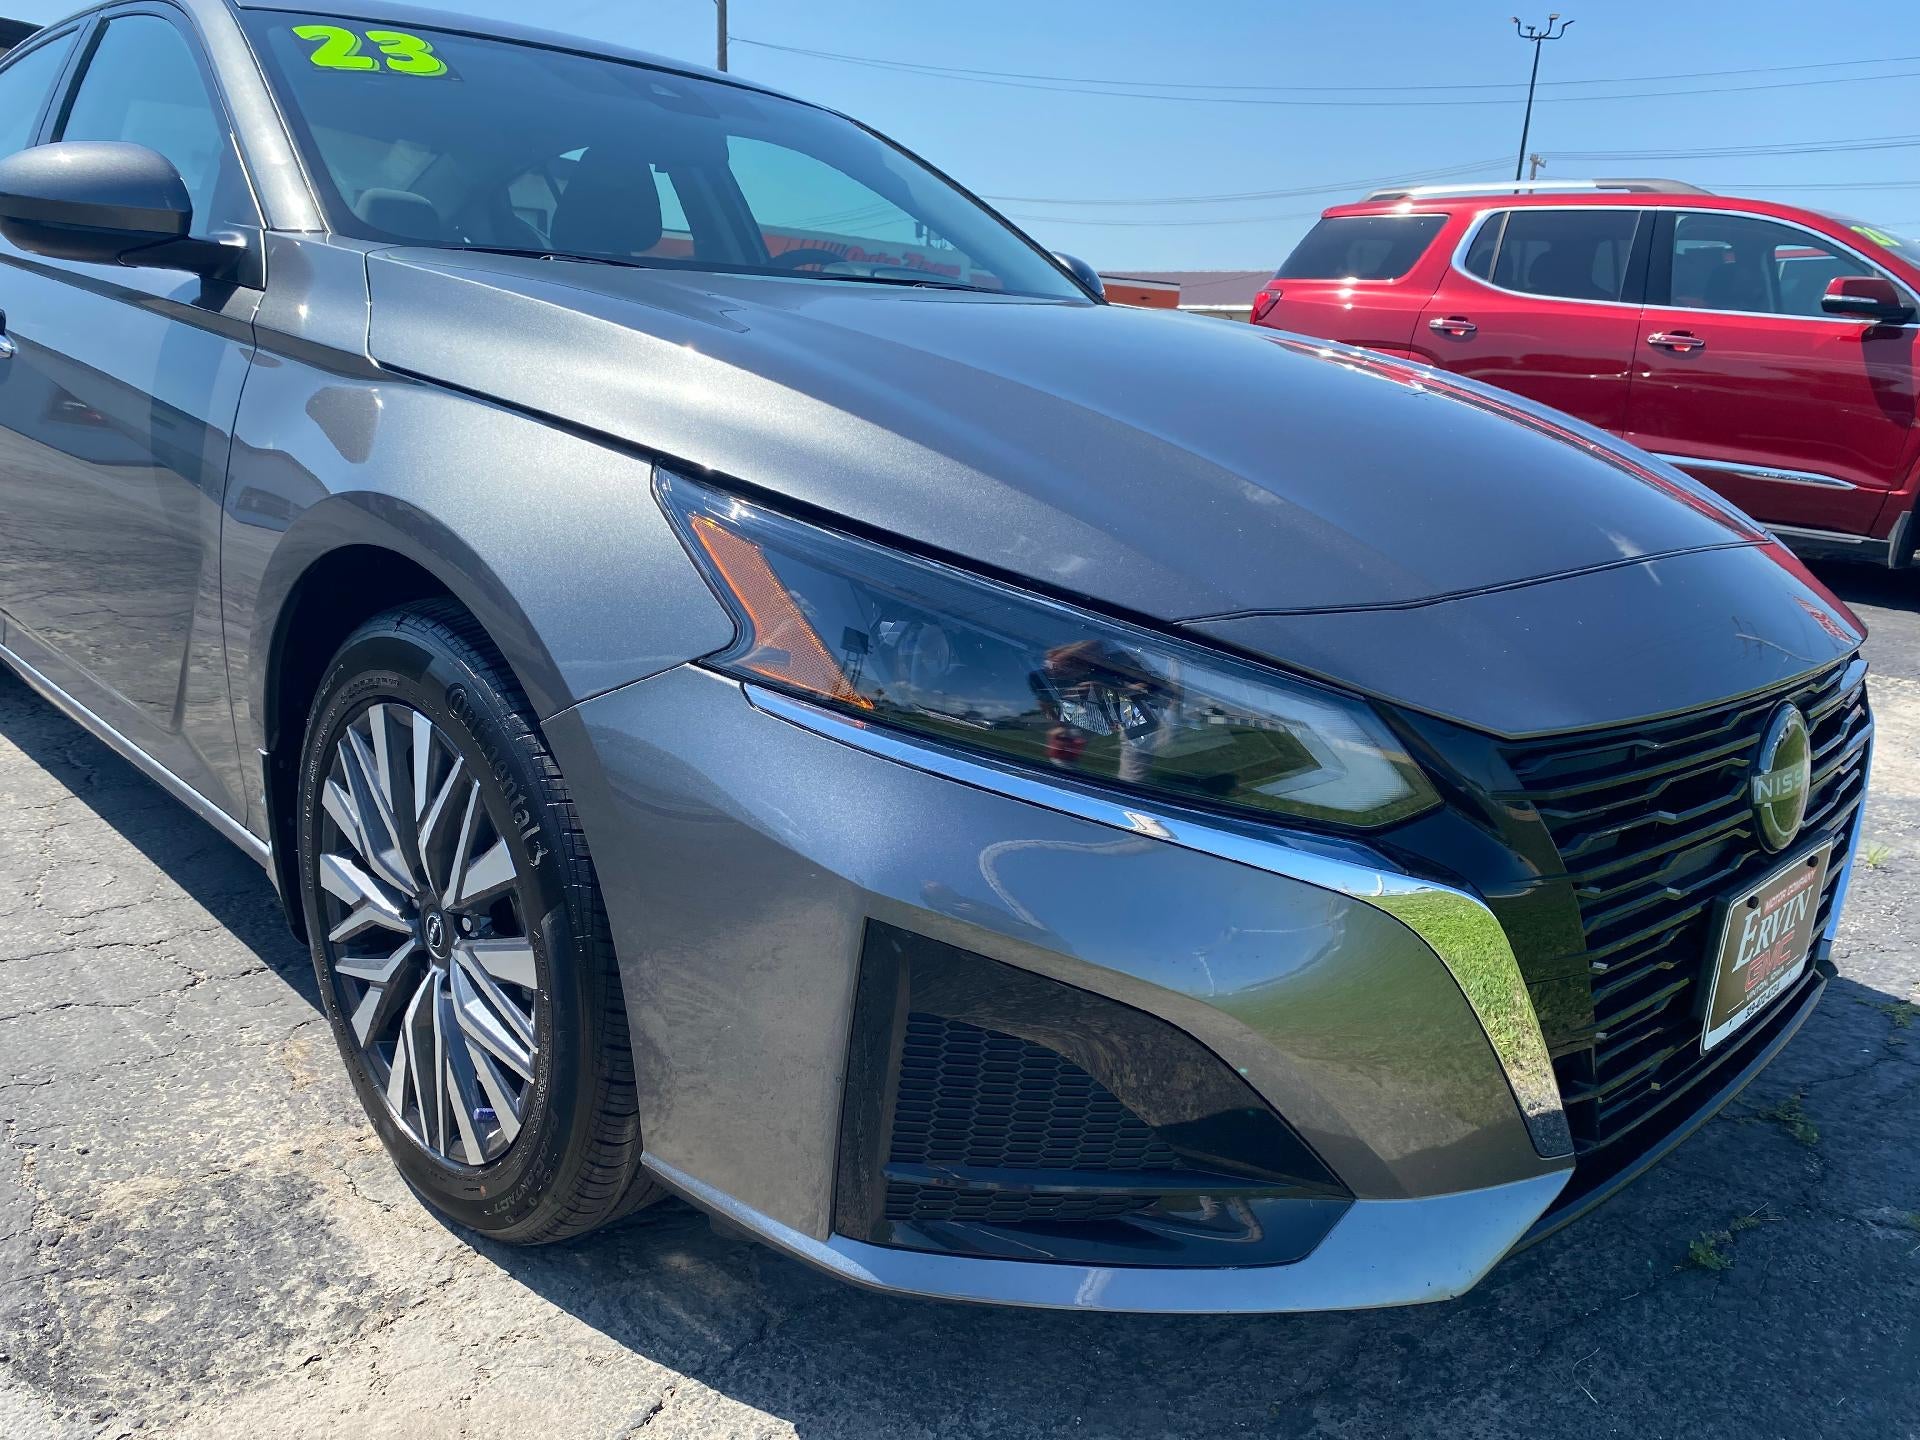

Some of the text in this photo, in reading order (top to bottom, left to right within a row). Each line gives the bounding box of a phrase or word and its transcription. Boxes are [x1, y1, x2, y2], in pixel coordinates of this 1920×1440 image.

[291, 25, 448, 77] 23
[1754, 766, 1806, 801] NISS
[1732, 885, 1814, 974] ERVIN
[1745, 931, 1795, 992] GMC
